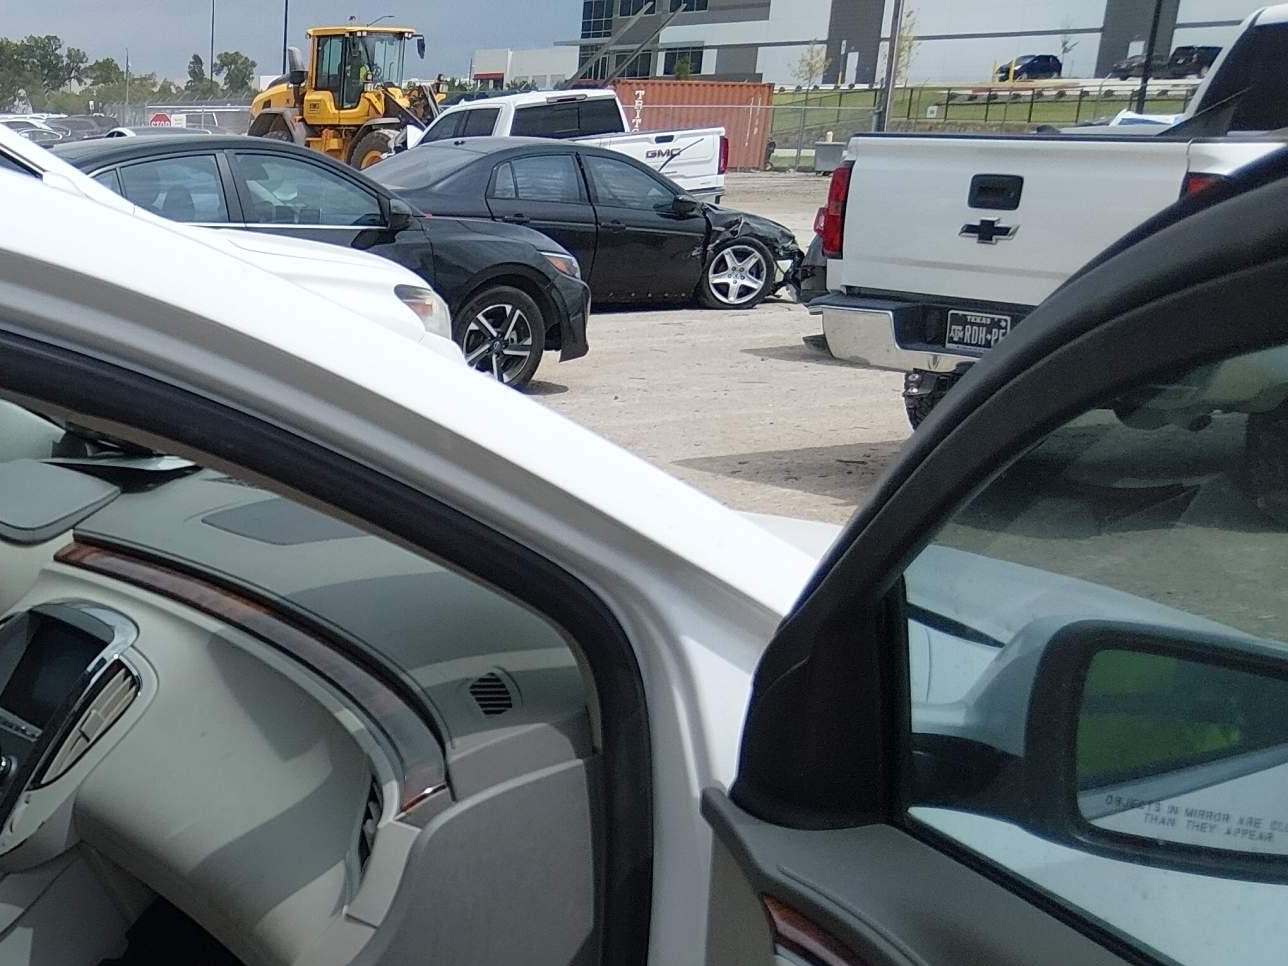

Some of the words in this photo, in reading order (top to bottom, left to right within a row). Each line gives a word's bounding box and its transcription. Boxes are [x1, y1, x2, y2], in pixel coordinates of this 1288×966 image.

[646, 148, 681, 158] GMC
[1183, 807, 1231, 823] MIRROR
[1143, 813, 1177, 828] THAN
[1185, 820, 1218, 833] THEY
[1223, 827, 1274, 843] APPEAR
